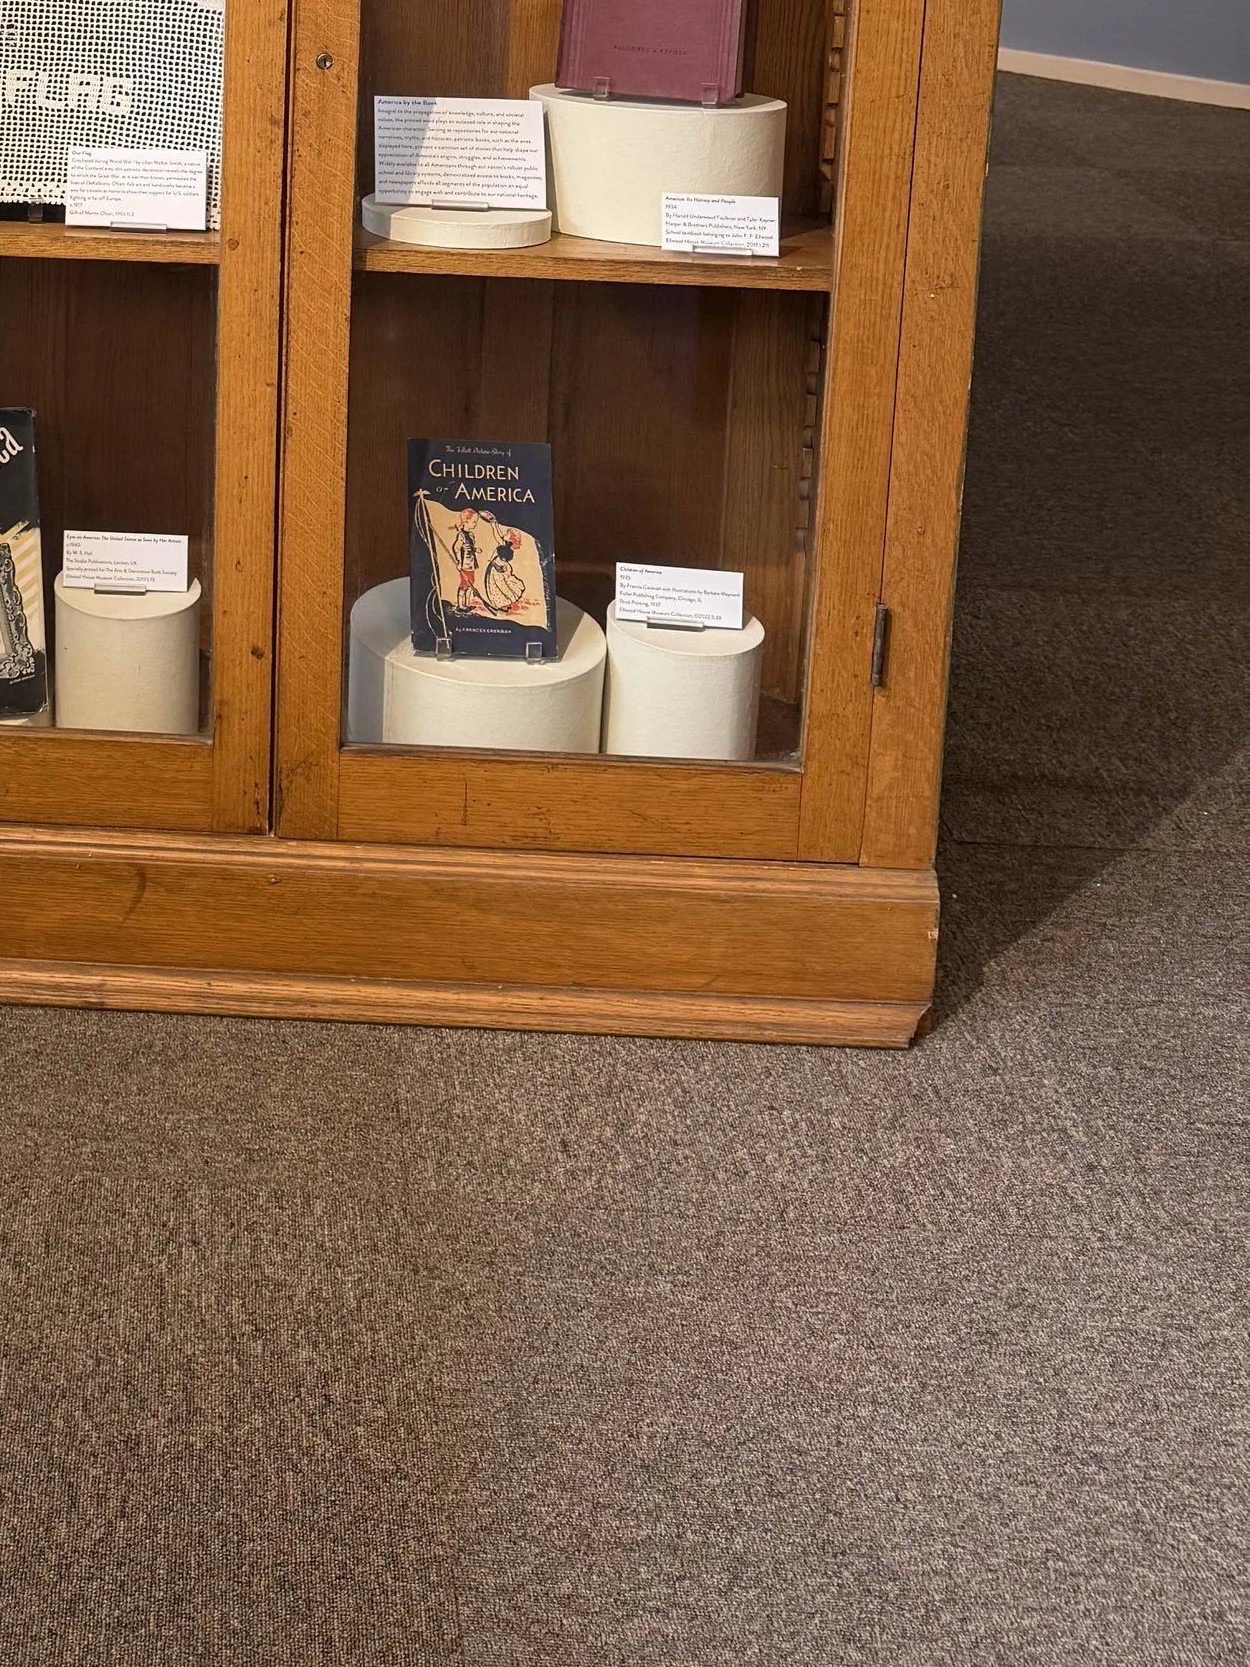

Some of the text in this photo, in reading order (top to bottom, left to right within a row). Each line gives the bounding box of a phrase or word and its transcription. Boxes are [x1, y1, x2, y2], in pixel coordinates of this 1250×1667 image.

[6, 69, 135, 114] FLAG
[428, 459, 519, 480] CHILDREN
[454, 482, 535, 503] AMERICA
